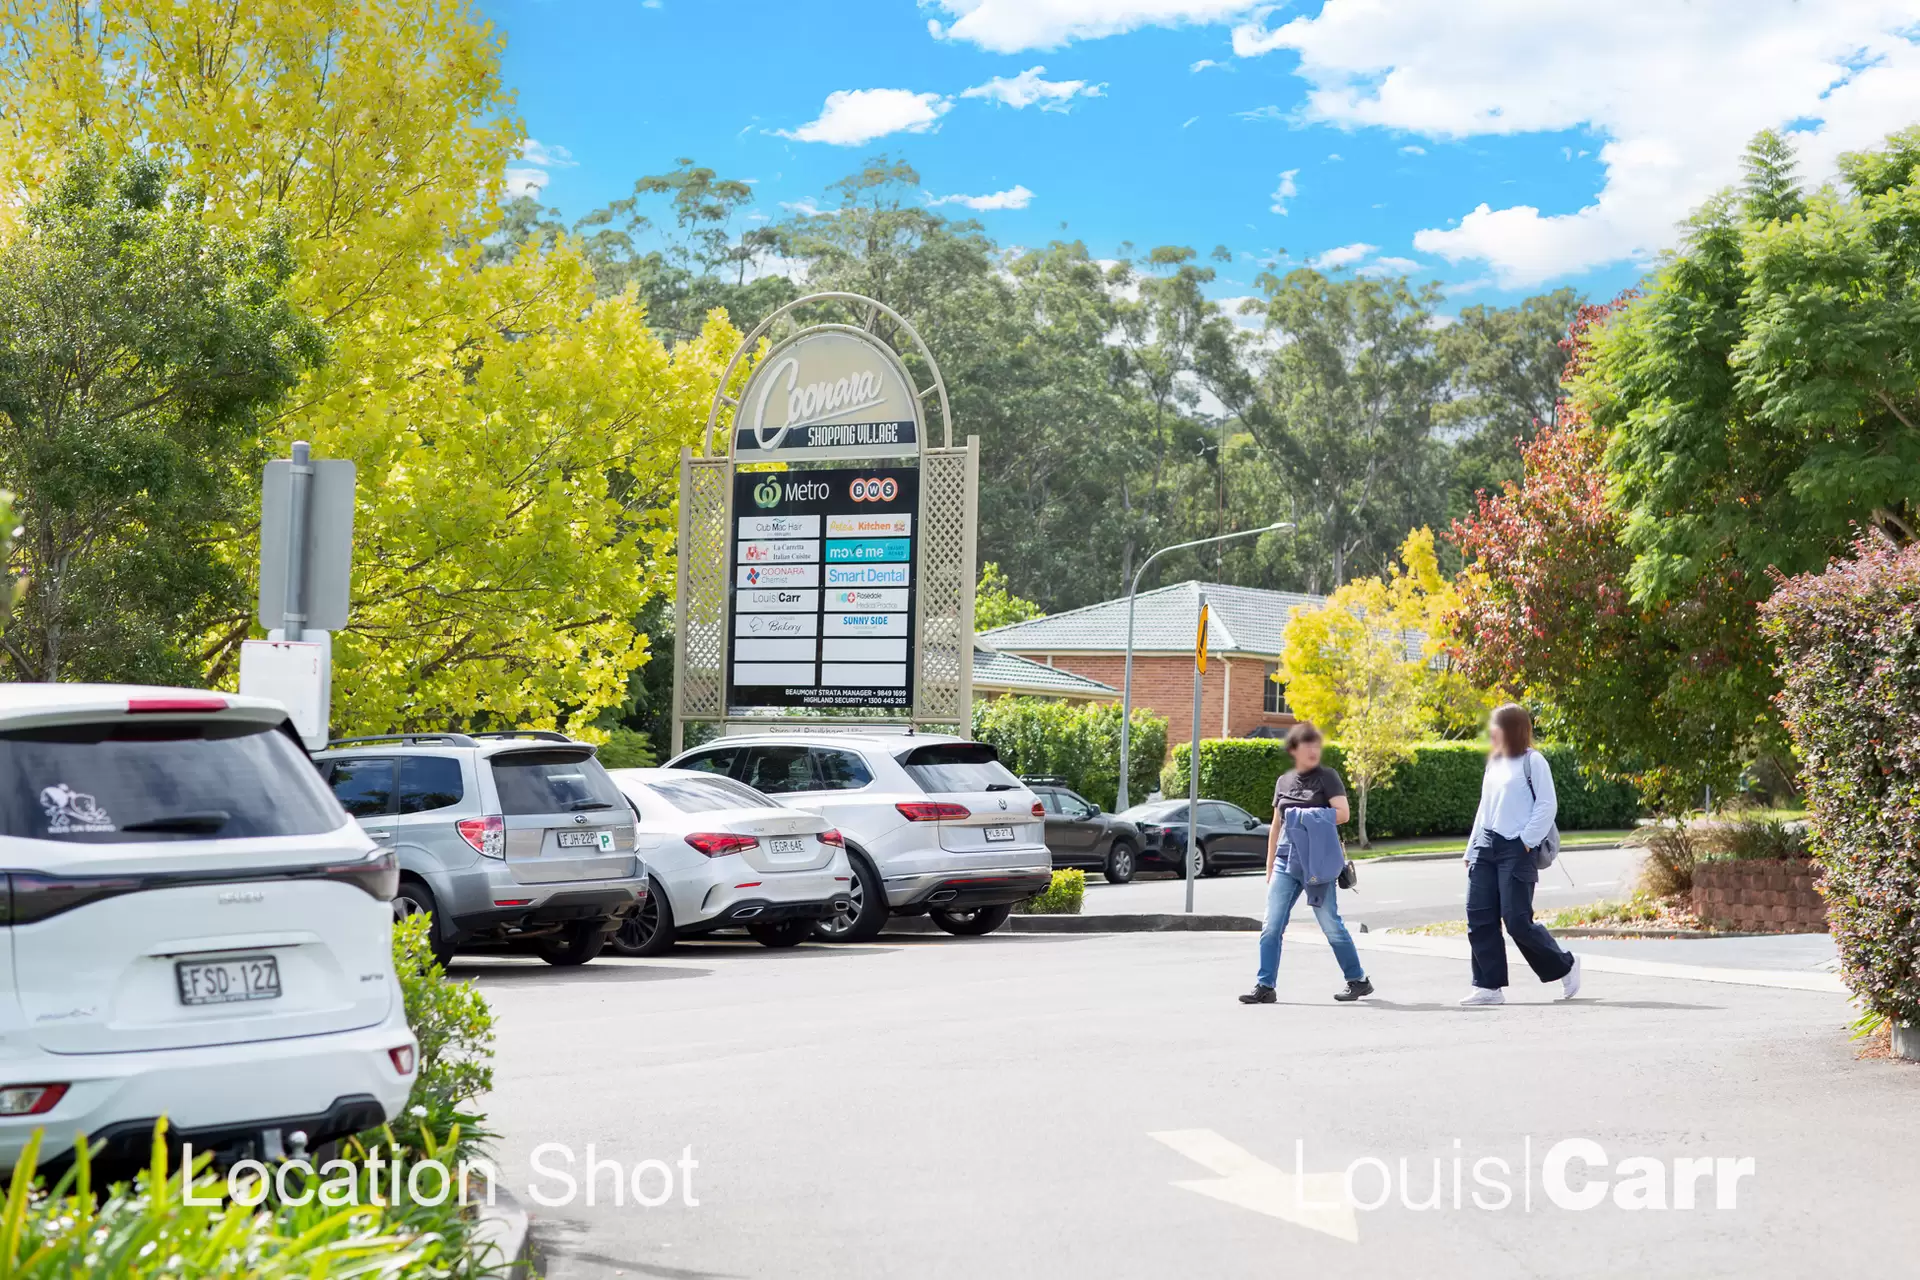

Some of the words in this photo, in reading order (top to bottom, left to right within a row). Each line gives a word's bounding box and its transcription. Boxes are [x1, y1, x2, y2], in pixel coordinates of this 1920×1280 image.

[754, 356, 888, 450] Coonara
[807, 425, 855, 446] SHOPPING
[857, 423, 898, 444] VILLAGE
[785, 480, 830, 501] Metro
[755, 523, 771, 532] Club
[772, 523, 787, 532] Mac
[788, 522, 803, 531] Hair
[858, 520, 891, 531] Kitchen
[829, 545, 863, 558] move
[865, 547, 884, 558] me
[761, 567, 805, 576] COONARA
[829, 568, 865, 583] Smart
[867, 567, 906, 582] Dental
[761, 576, 788, 584] Chemist
[856, 592, 882, 600] Rosedale
[843, 616, 869, 625] SUNNY
[870, 616, 888, 625] SIDE
[768, 620, 802, 635] Bakery
[785, 688, 818, 696] BEAUMONT
[842, 689, 872, 697] MANAGER
[803, 696, 834, 704] HIGHLAND
[601, 835, 610, 848] P
